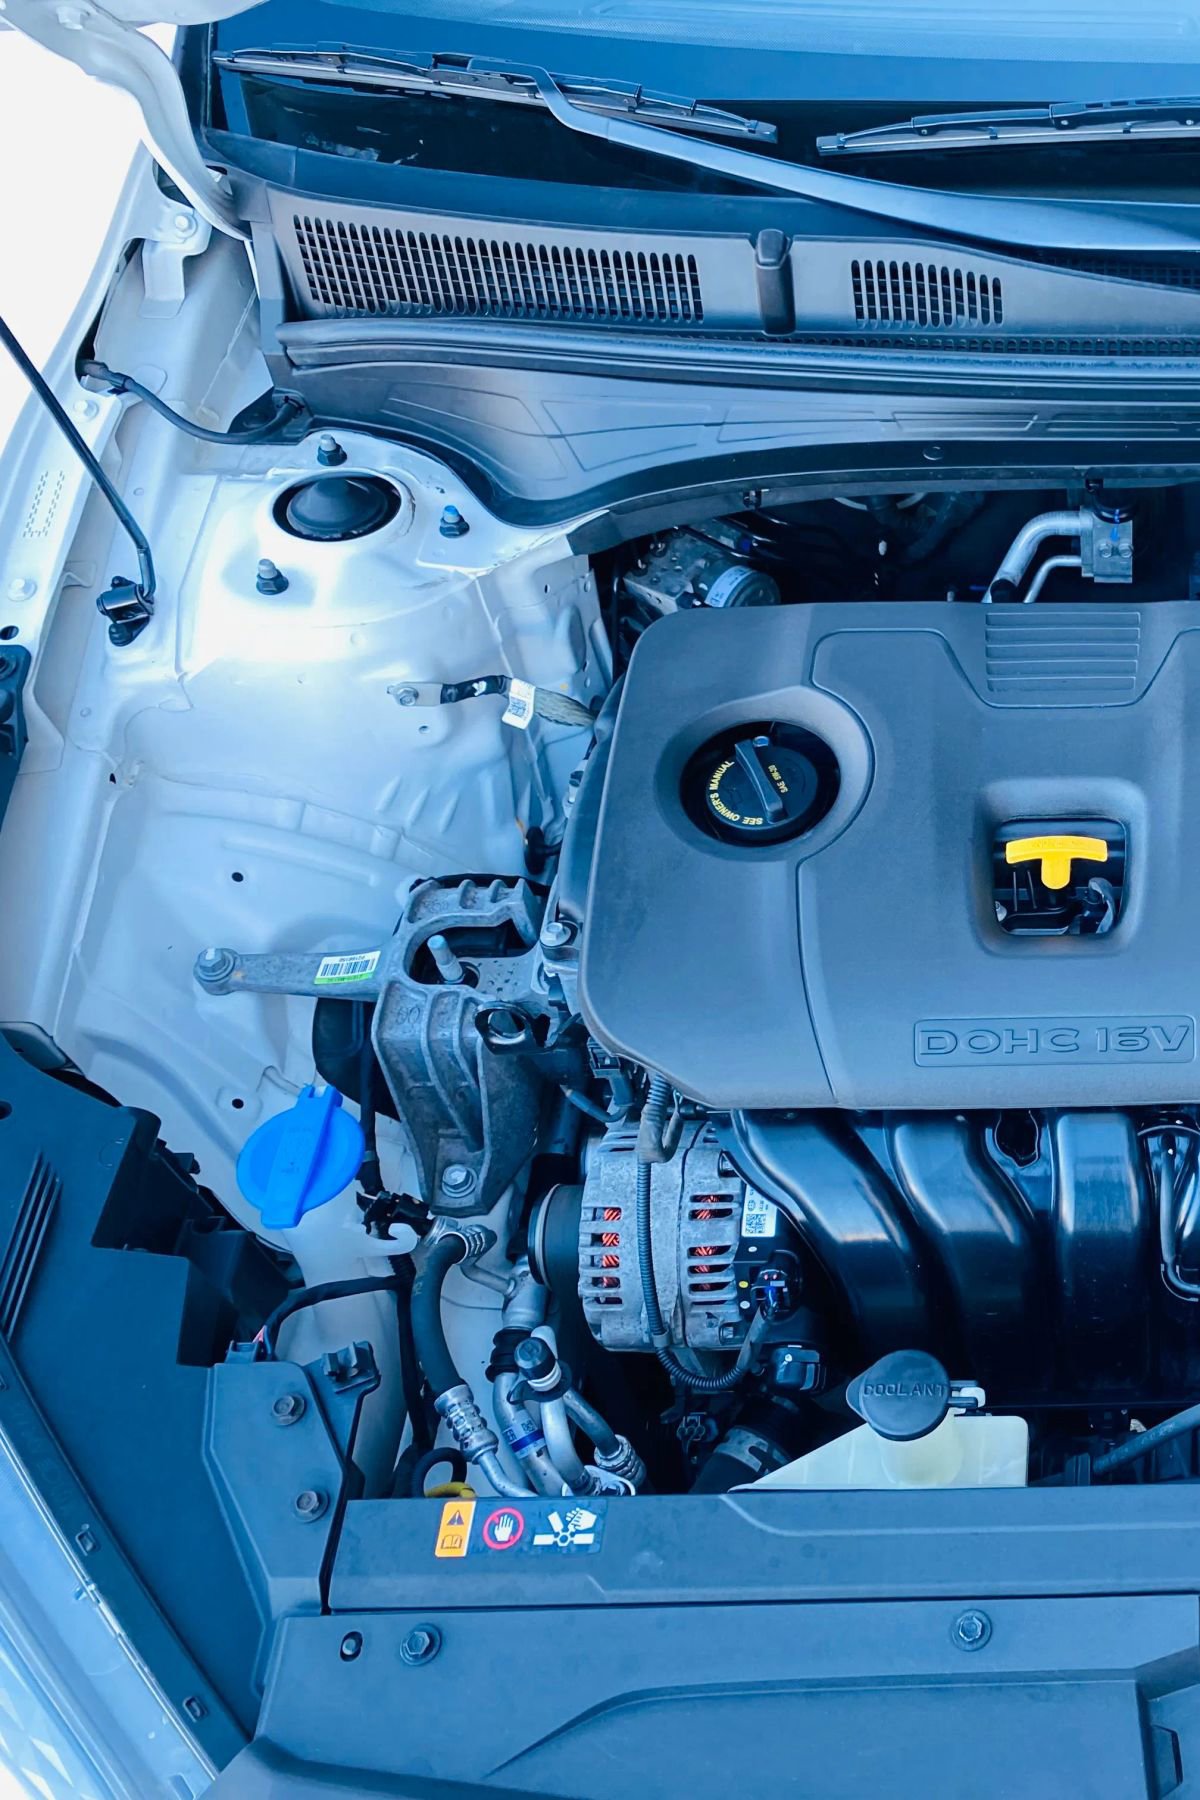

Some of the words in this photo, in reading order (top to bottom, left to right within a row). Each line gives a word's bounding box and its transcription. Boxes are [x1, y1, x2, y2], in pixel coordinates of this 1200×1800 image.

[709, 761, 735, 790] MANUAL
[776, 781, 788, 793] SAE
[710, 792, 740, 821] OWNER'S
[742, 816, 763, 825] SEE
[920, 1028, 1080, 1054] DOHC
[1096, 1025, 1189, 1052] 16V
[864, 1383, 945, 1397] COOLANT
